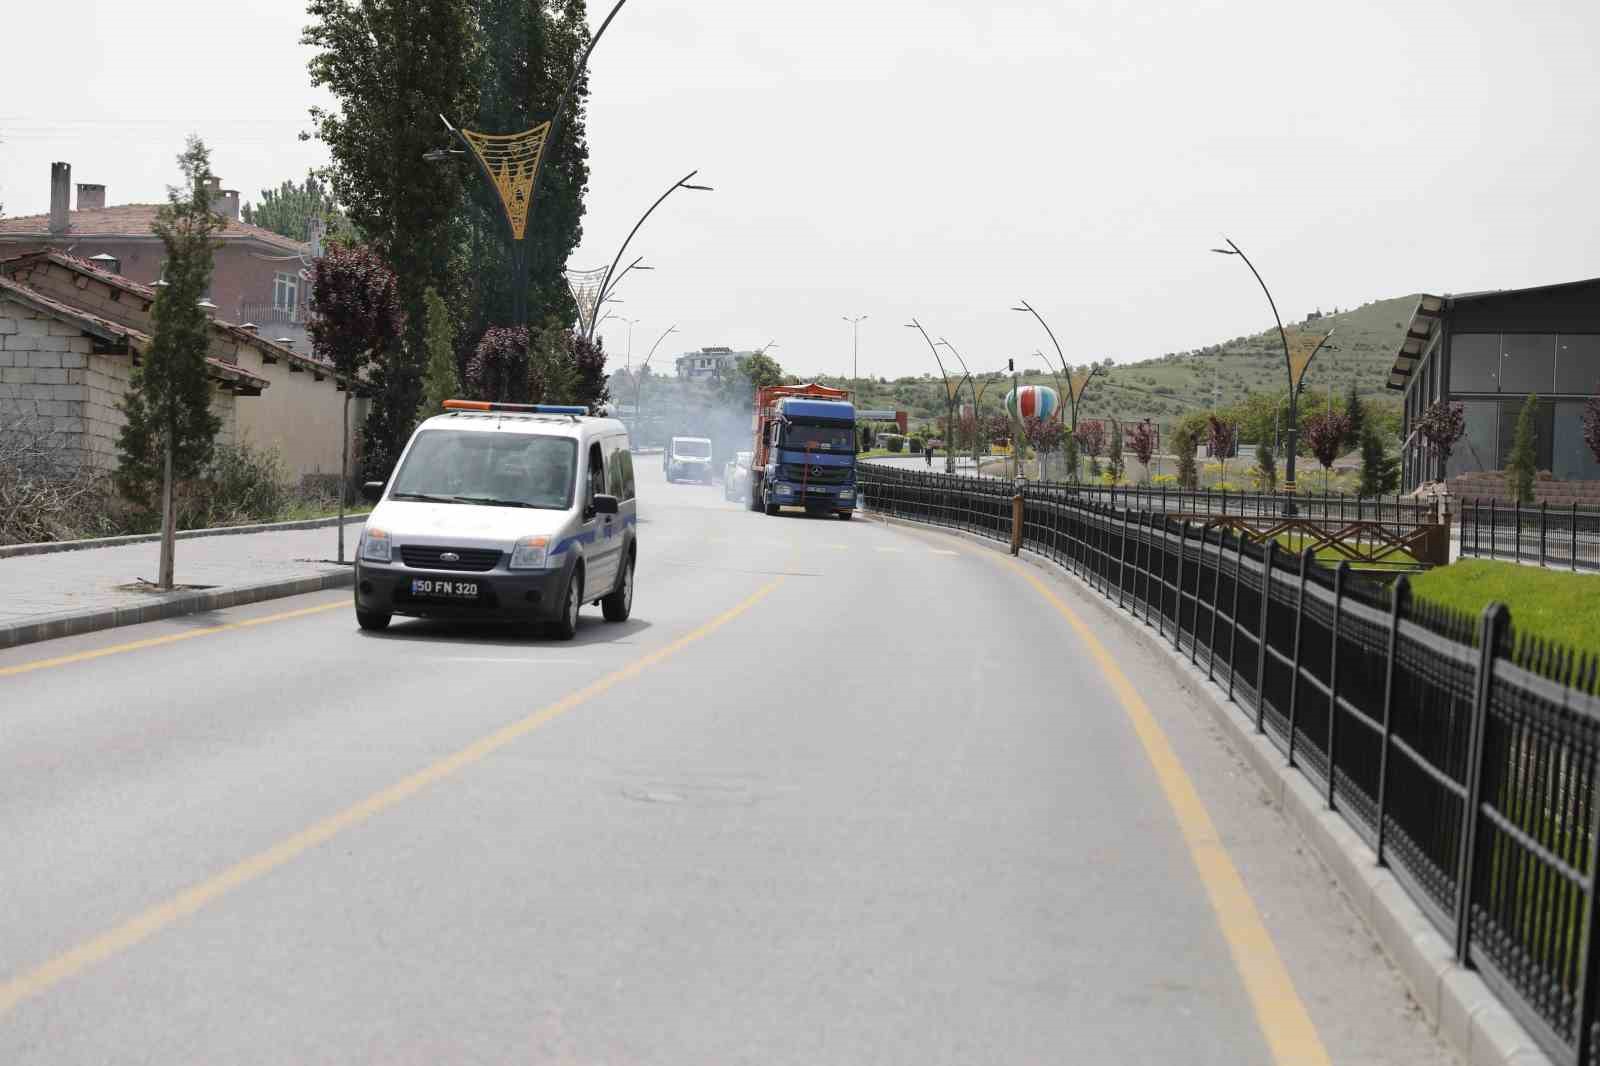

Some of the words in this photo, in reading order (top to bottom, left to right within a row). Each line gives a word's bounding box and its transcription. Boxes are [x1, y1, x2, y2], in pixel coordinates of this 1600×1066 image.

[417, 580, 432, 592] 50
[435, 581, 453, 593] FN
[455, 582, 478, 595] 320
